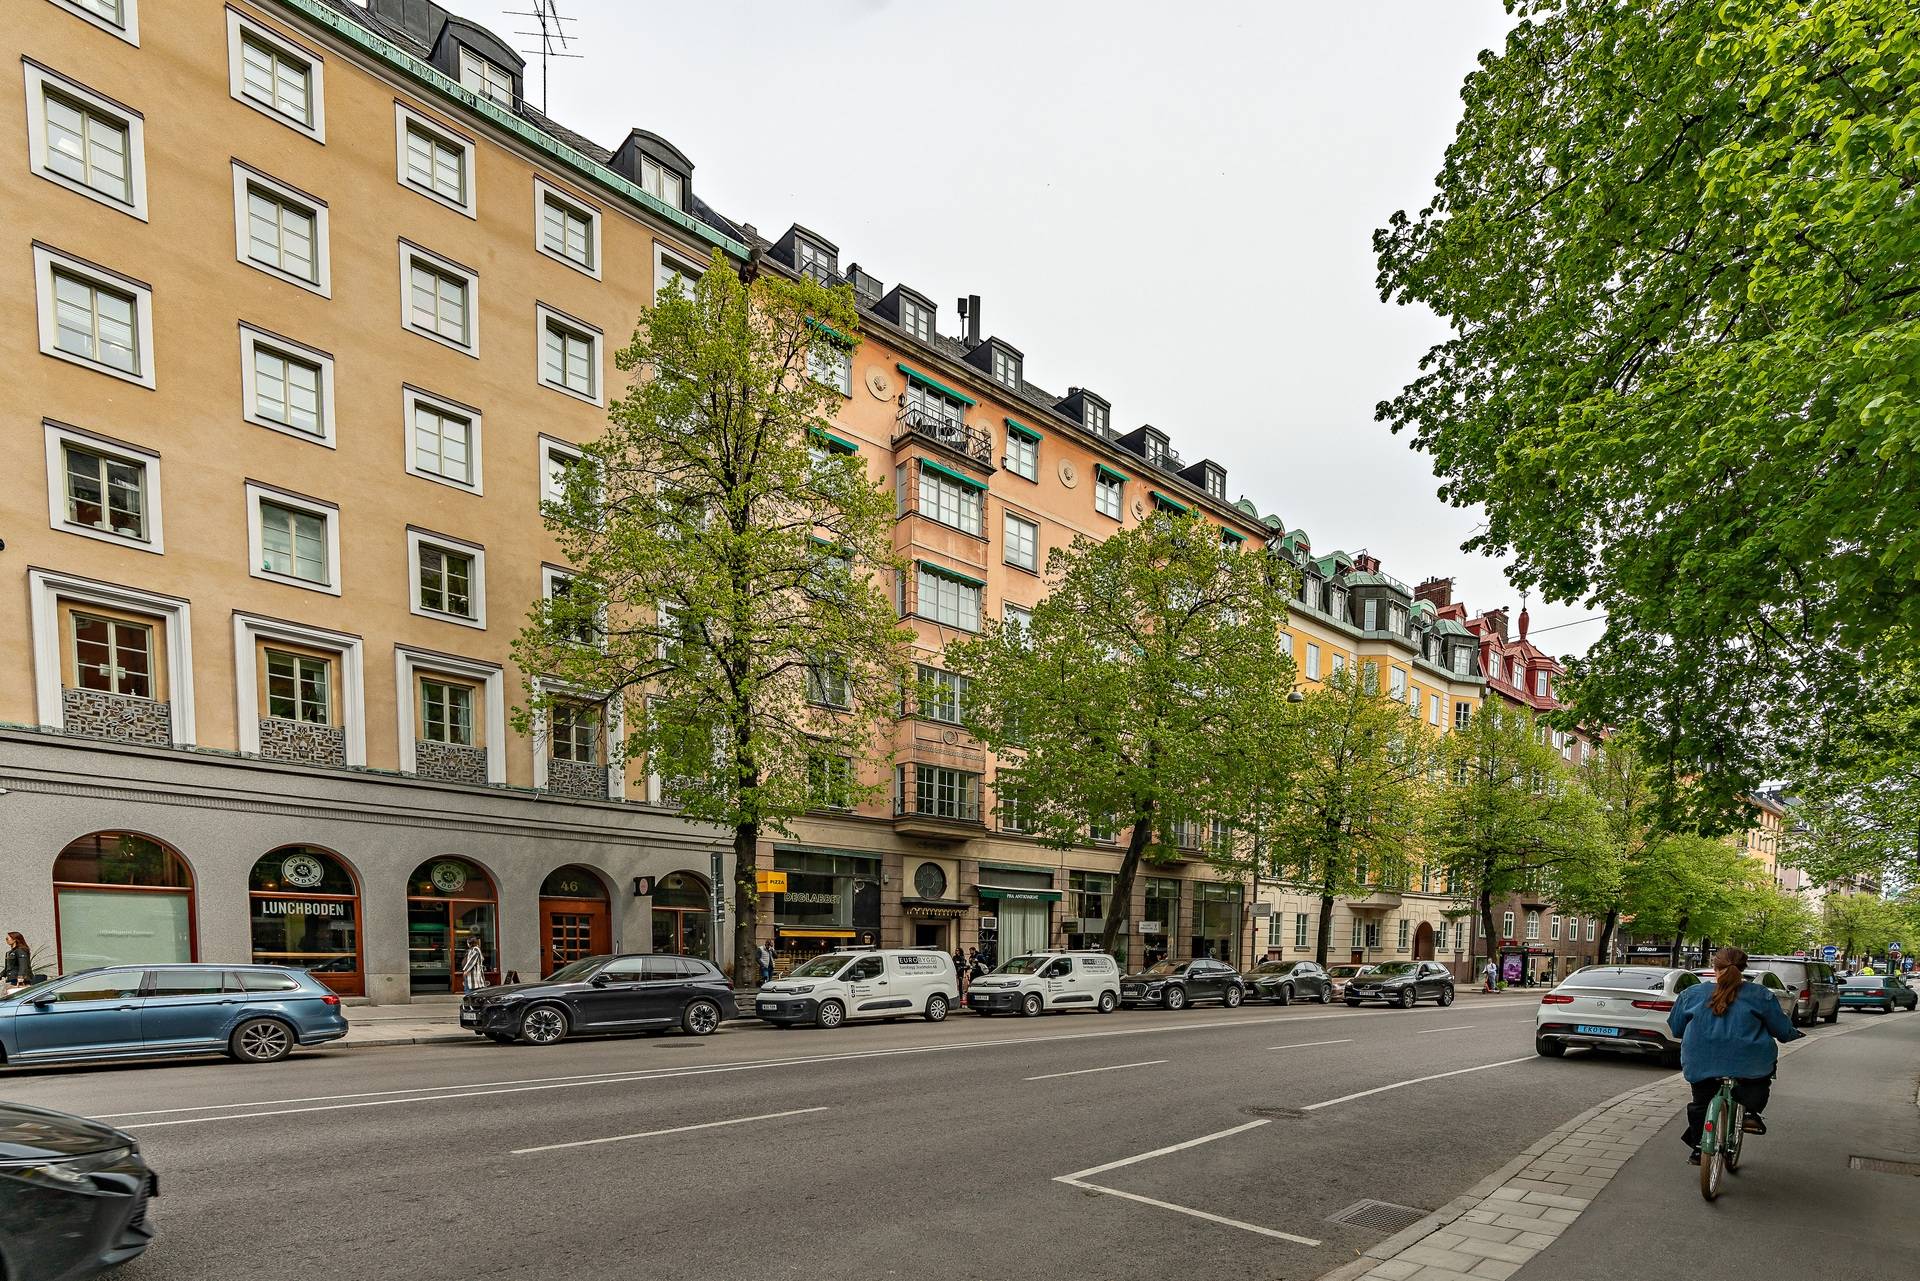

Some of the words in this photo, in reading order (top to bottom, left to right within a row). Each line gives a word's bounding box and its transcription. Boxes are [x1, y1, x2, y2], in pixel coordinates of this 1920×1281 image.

[287, 858, 318, 869] LUNCH
[288, 873, 318, 884] BODEN
[560, 881, 578, 892] 46
[262, 901, 344, 915] LUNCHBODEN
